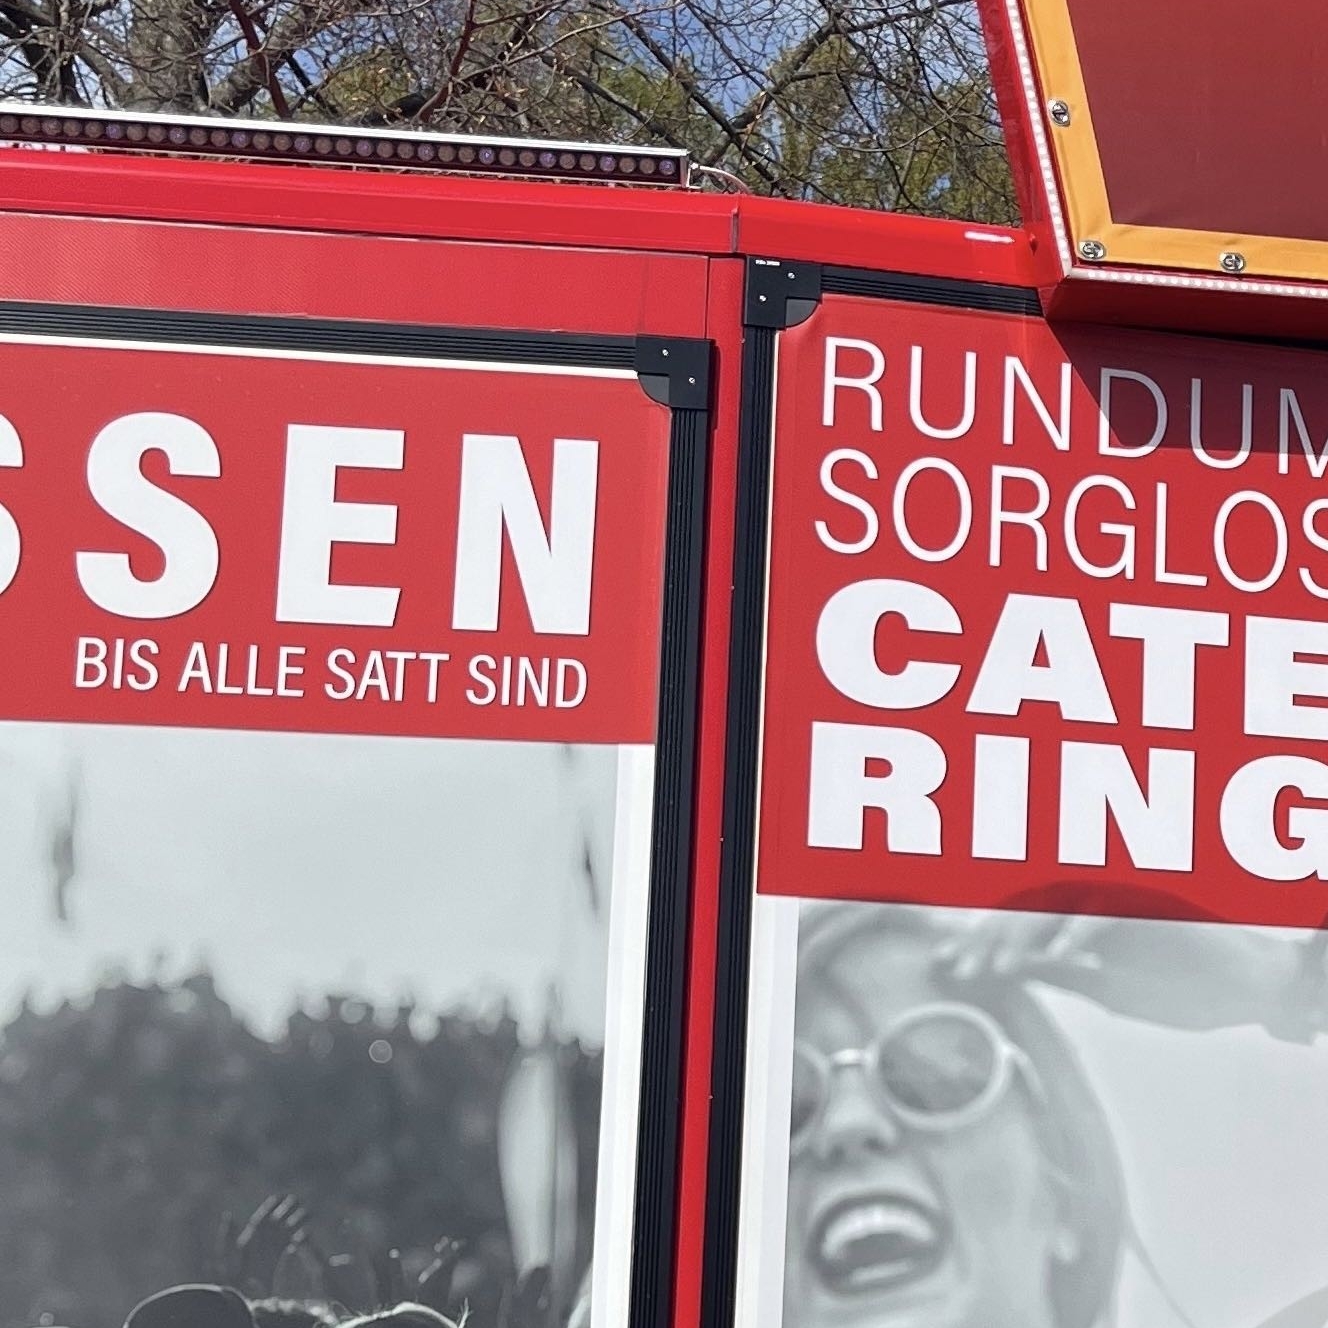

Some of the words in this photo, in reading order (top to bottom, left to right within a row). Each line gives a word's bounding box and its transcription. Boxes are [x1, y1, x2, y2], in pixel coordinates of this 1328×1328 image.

[0, 410, 599, 637] SEN
[75, 636, 160, 691] BIS
[178, 641, 306, 698] ALLE
[324, 647, 450, 703] SATT
[466, 654, 588, 709] SIND
